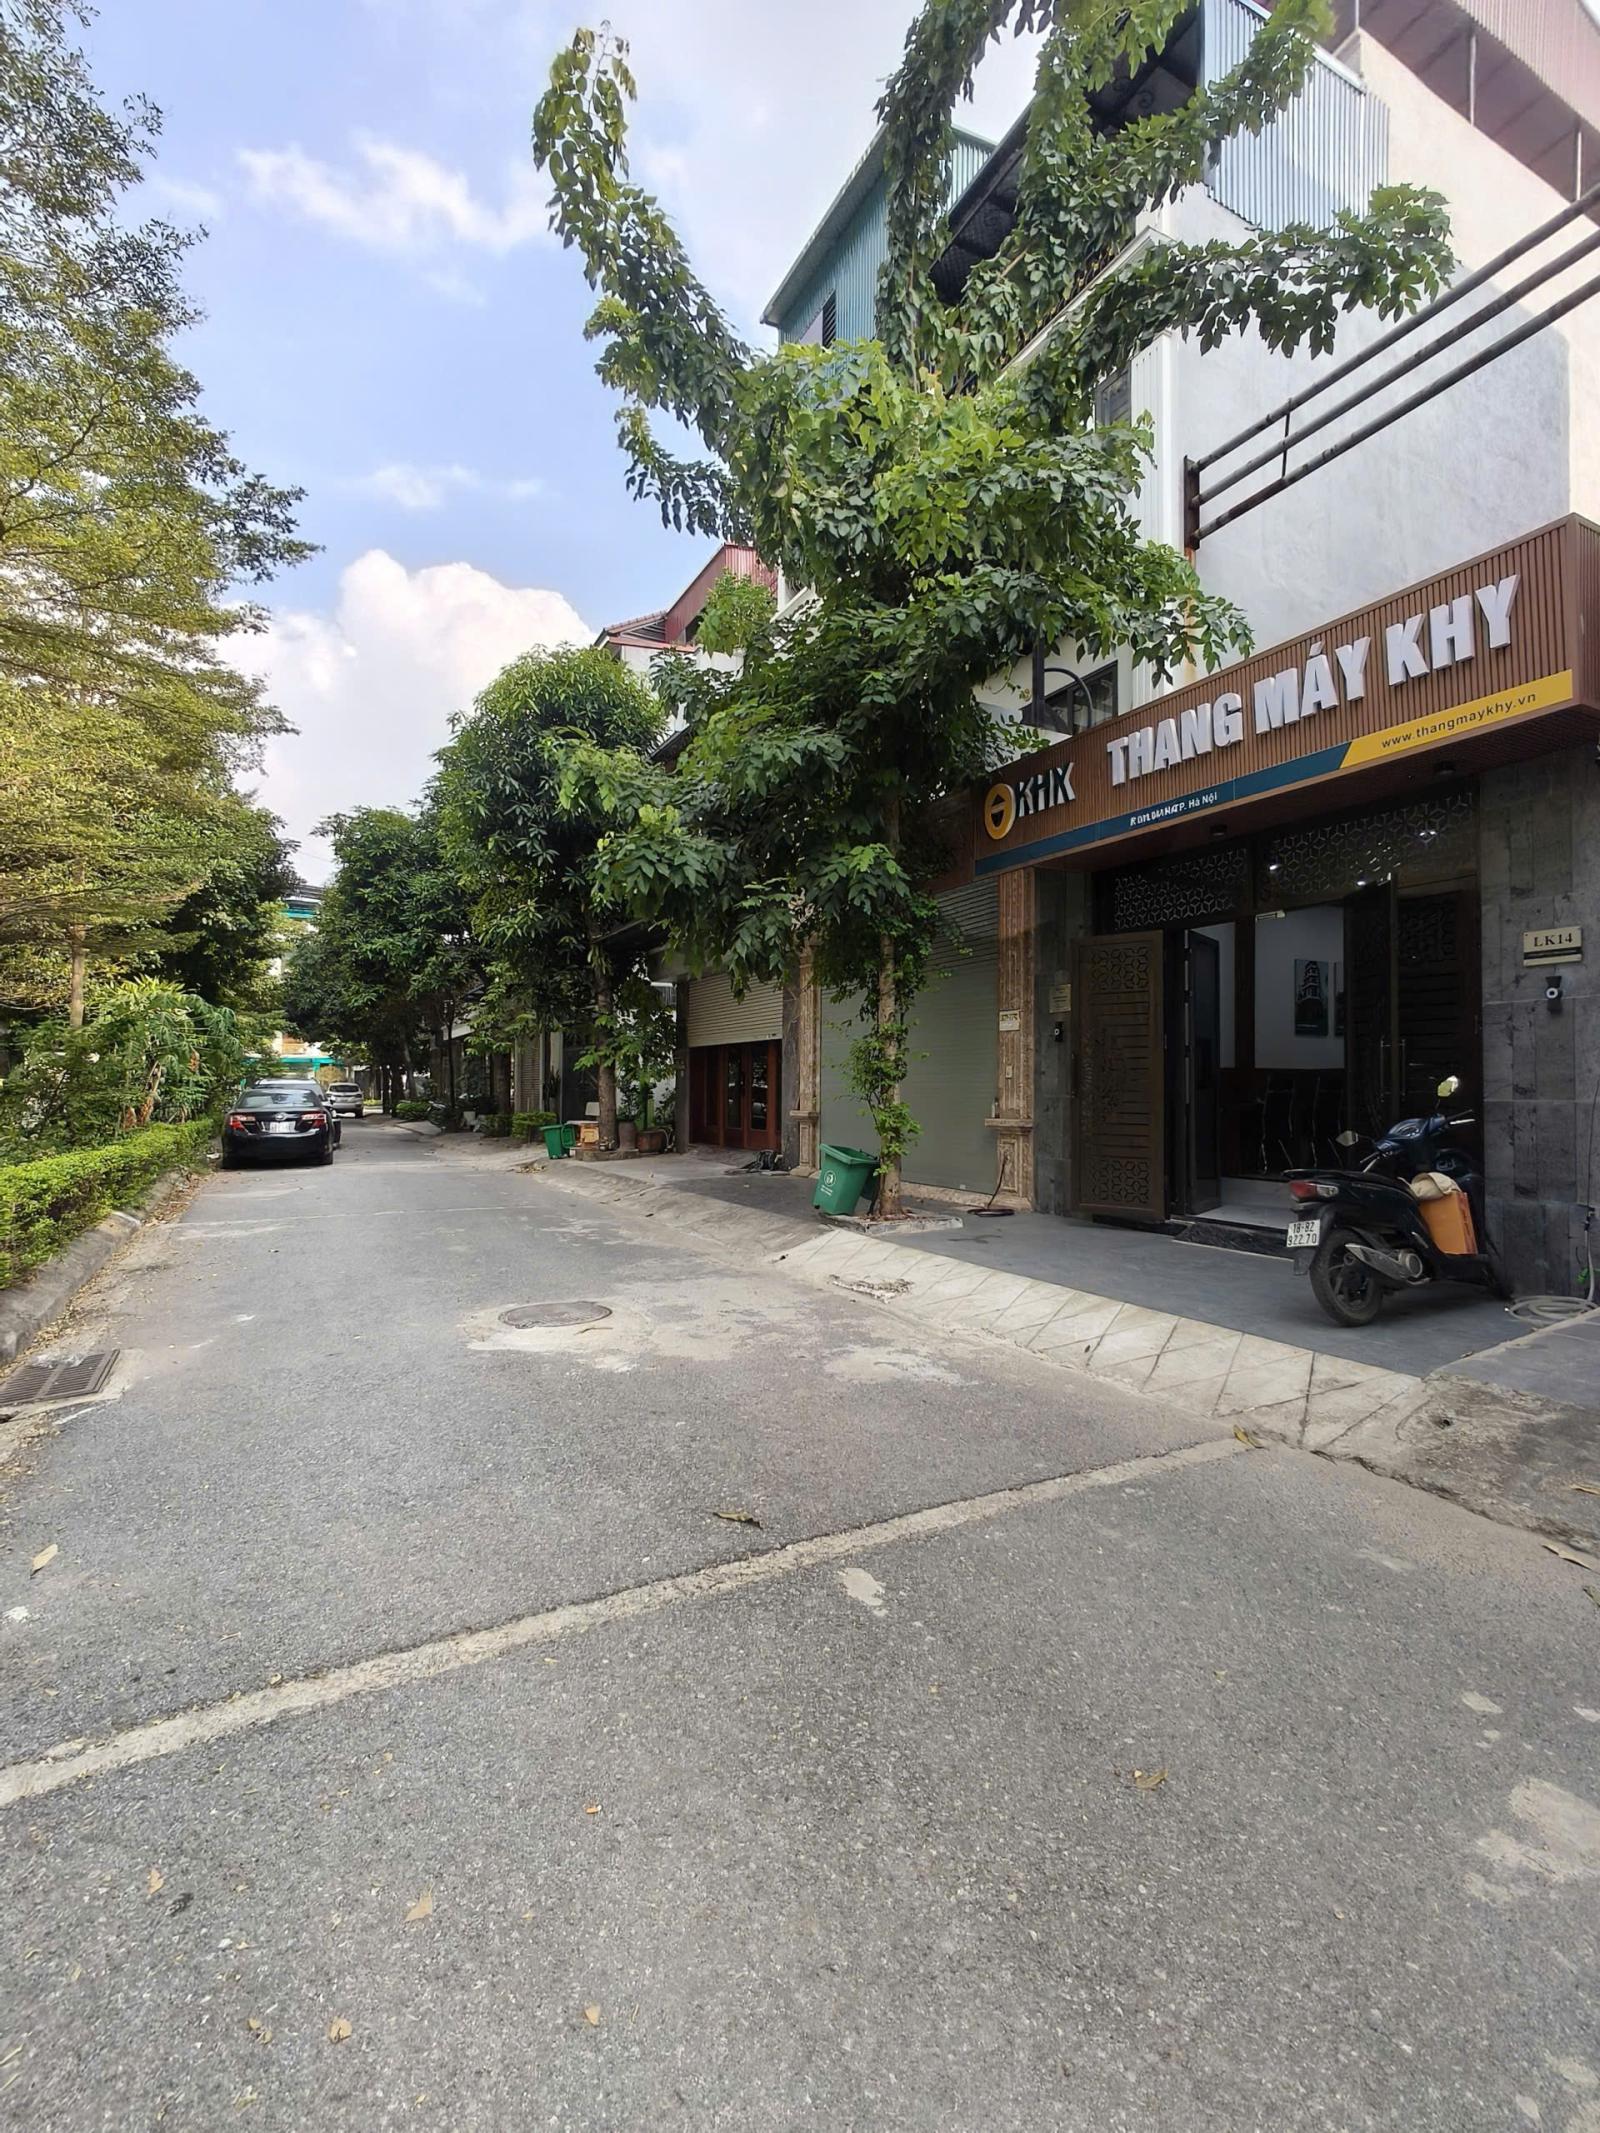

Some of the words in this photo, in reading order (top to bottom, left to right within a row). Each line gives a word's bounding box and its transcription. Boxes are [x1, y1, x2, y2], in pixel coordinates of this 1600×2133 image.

[1106, 692, 1245, 787] THANG
[1254, 636, 1372, 735] MÁY
[1385, 574, 1523, 687] KHY
[1381, 693, 1537, 748] www.thangmaykhy.vn
[1533, 932, 1573, 947] LK14
